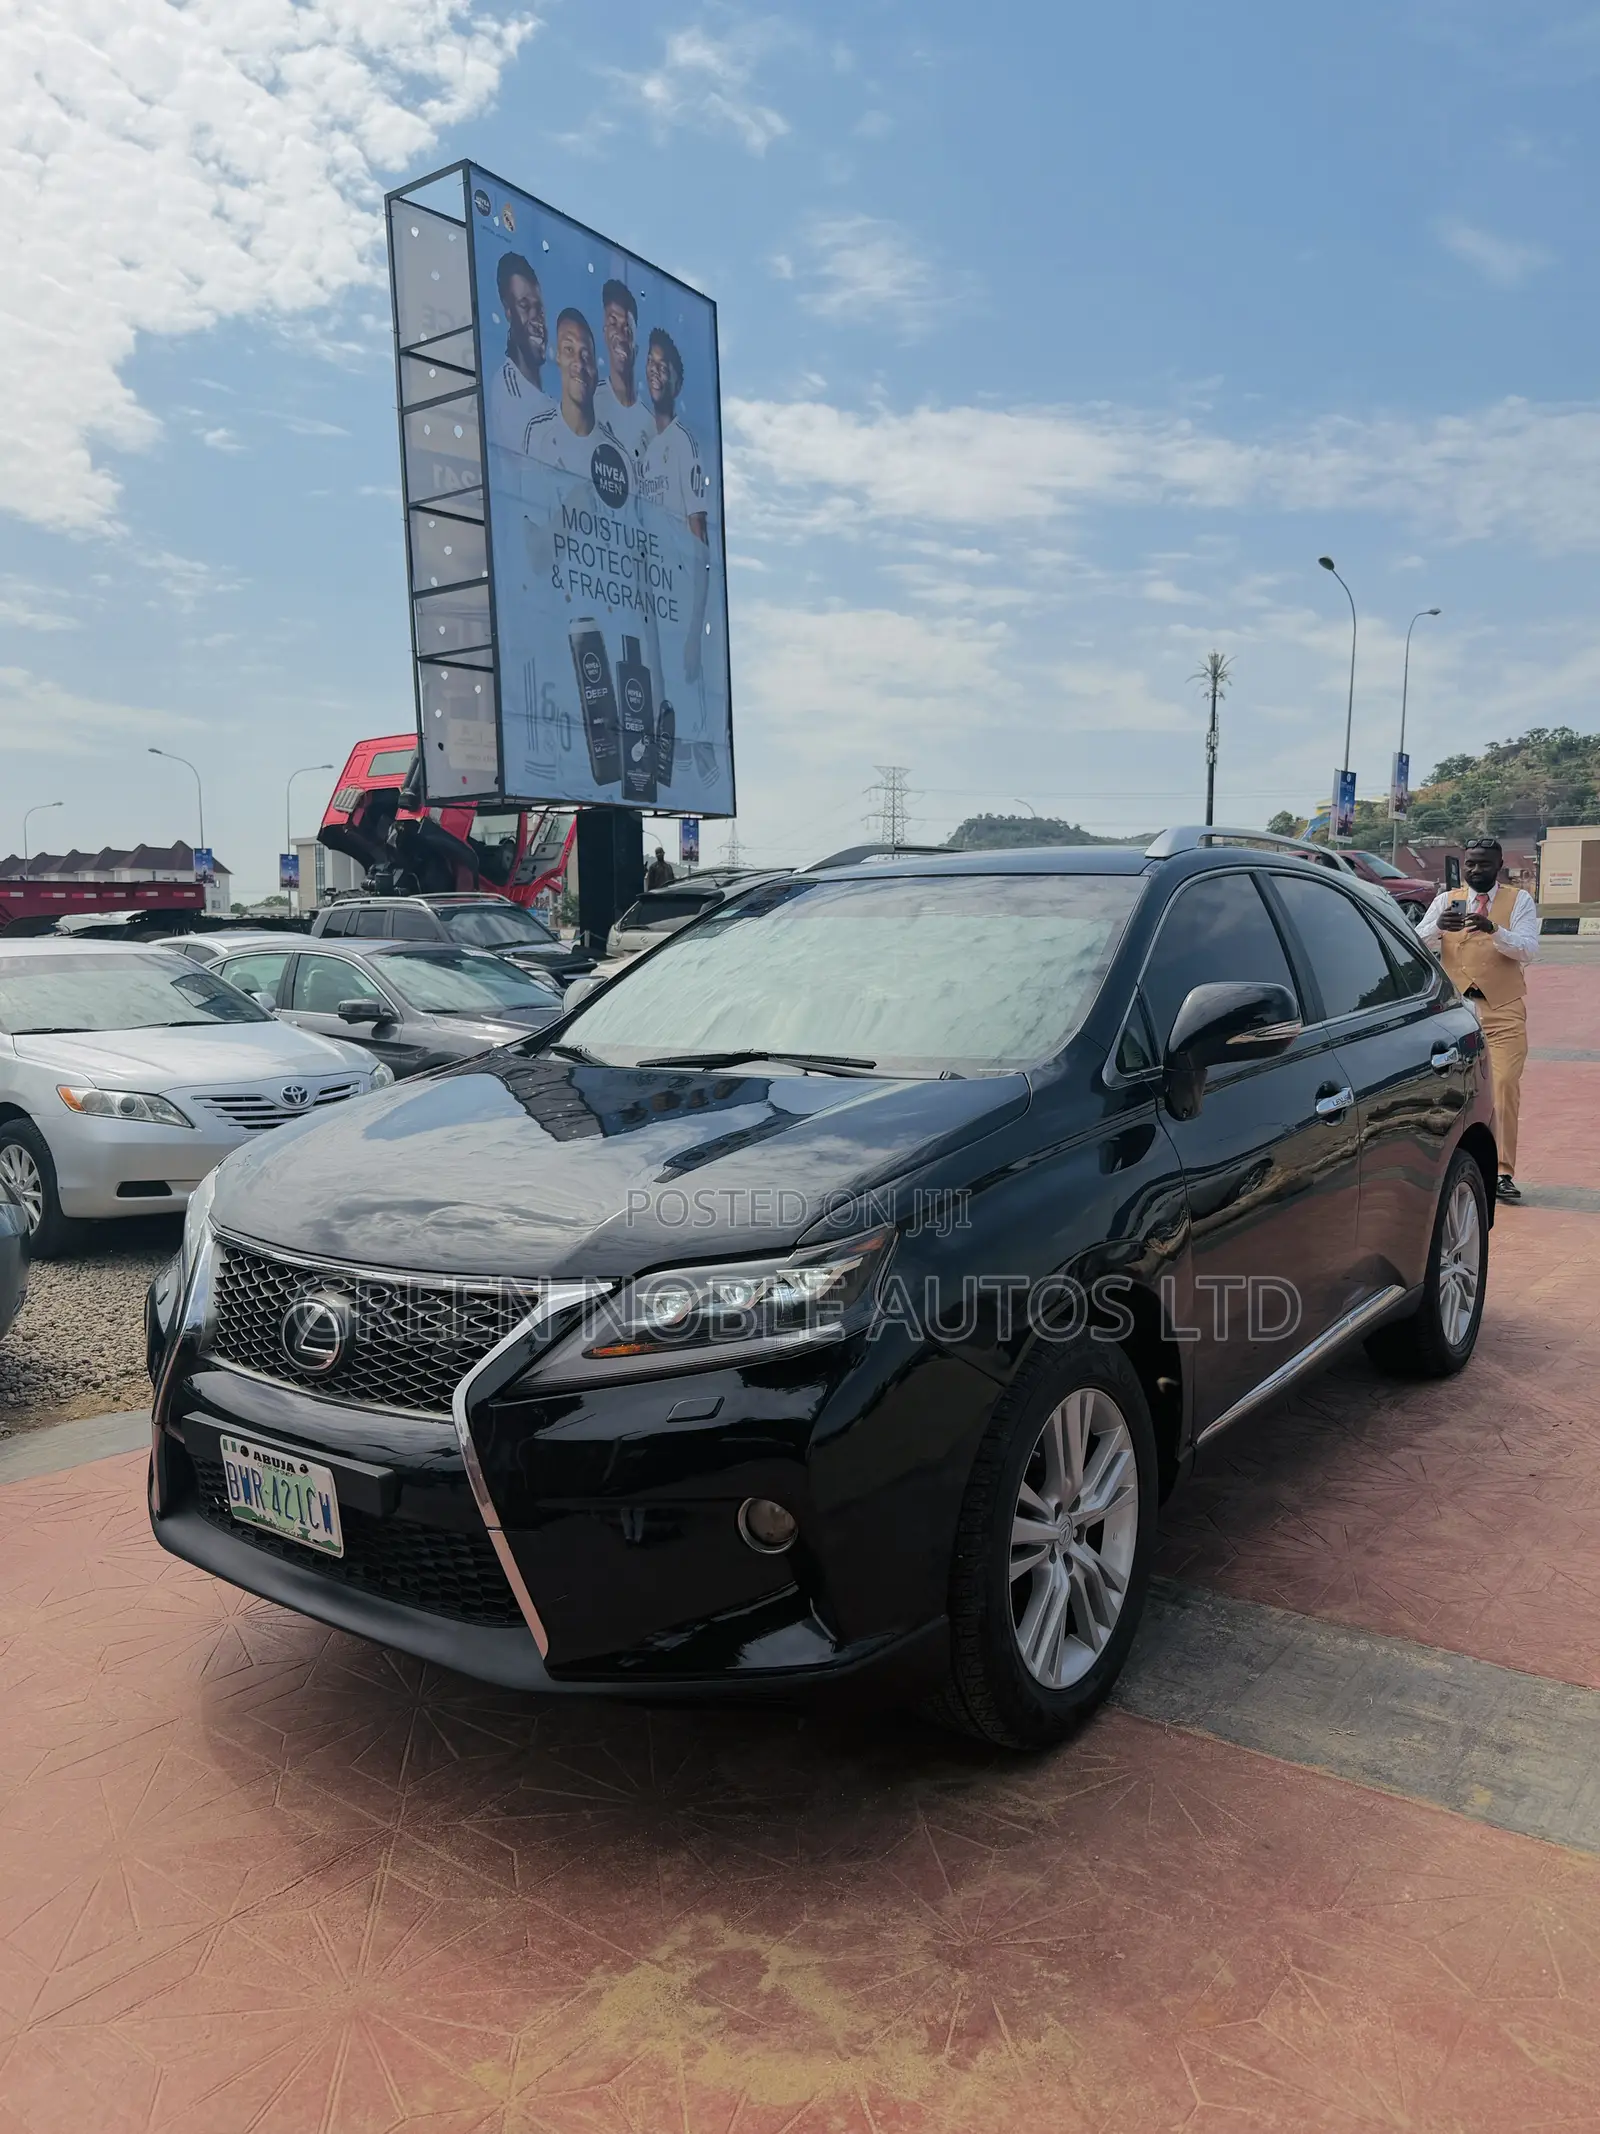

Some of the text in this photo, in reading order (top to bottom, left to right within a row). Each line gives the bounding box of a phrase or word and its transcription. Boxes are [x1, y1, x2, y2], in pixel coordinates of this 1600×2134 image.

[594, 461, 627, 484] NIVEA
[599, 477, 623, 496] MEN
[562, 504, 664, 563] MOISTURE,
[554, 533, 673, 592] PROTECTION
[551, 564, 679, 623] & FRAGRANCE
[585, 688, 608, 699] DEEP
[625, 722, 644, 731] DEEP
[253, 1451, 297, 1474] ABUJA
